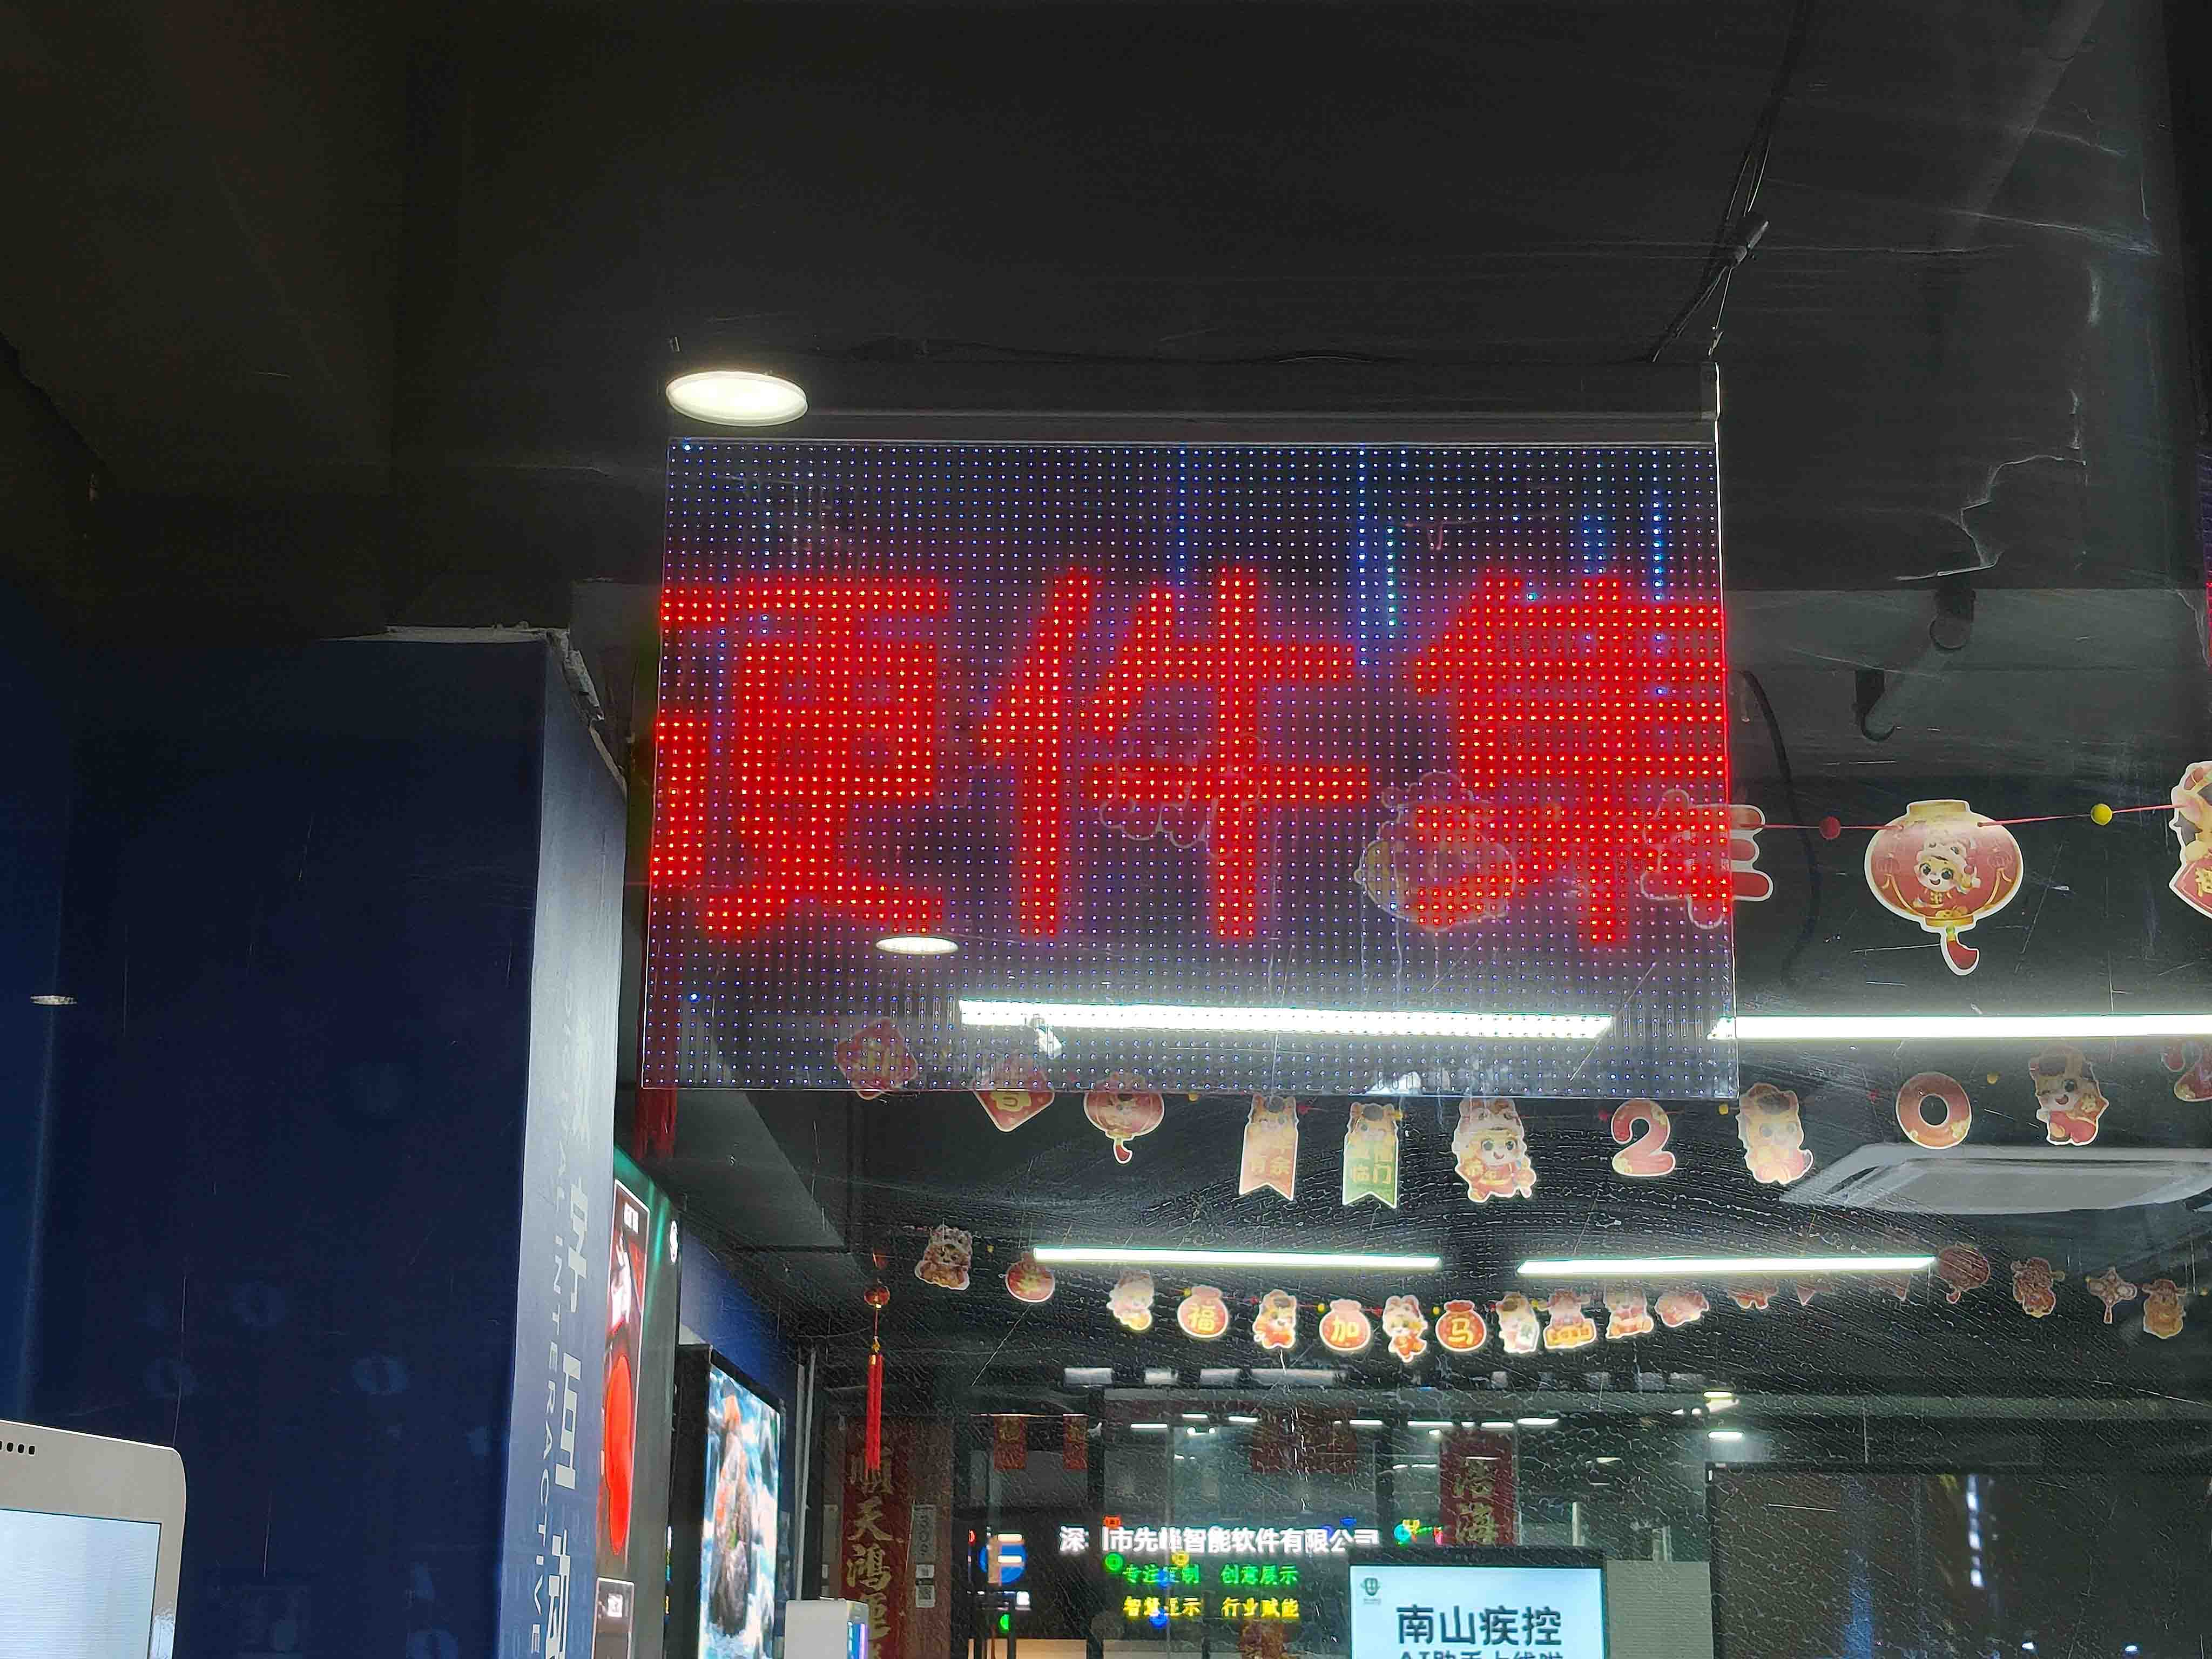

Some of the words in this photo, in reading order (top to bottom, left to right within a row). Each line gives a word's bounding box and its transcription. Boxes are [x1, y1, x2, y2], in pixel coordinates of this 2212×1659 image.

[545, 1015, 592, 1659] 字互动
[1187, 1303, 1216, 1331] 福
[1330, 1314, 1360, 1343] 加
[1447, 1317, 1474, 1345] 马
[531, 1235, 563, 1655] INTERACTIVE
[1220, 1564, 1299, 1585] 创意展示
[1220, 1596, 1299, 1617] 行业赋能
[1396, 1604, 1562, 1645] 南山疾控
